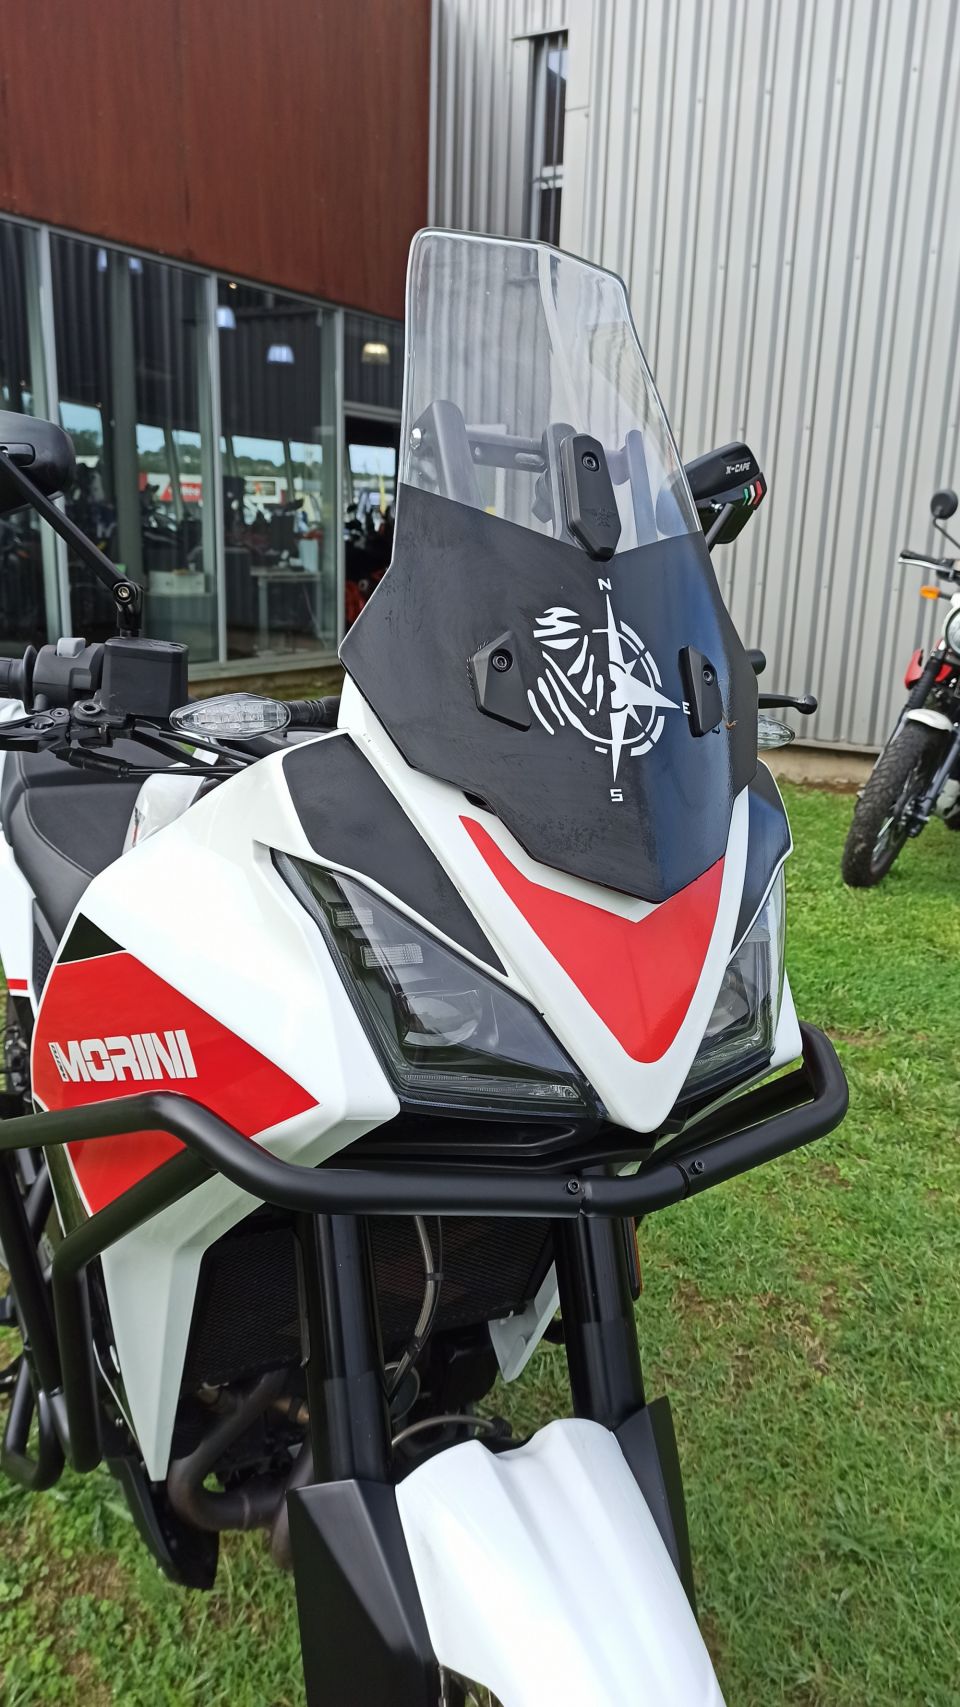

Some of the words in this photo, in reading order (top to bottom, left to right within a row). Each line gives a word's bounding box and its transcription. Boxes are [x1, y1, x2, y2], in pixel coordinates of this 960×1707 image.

[725, 461, 751, 475] X-CAPE
[597, 577, 612, 591] N
[682, 701, 691, 715] E
[610, 788, 623, 802] S
[49, 1029, 198, 1082] MORINI
